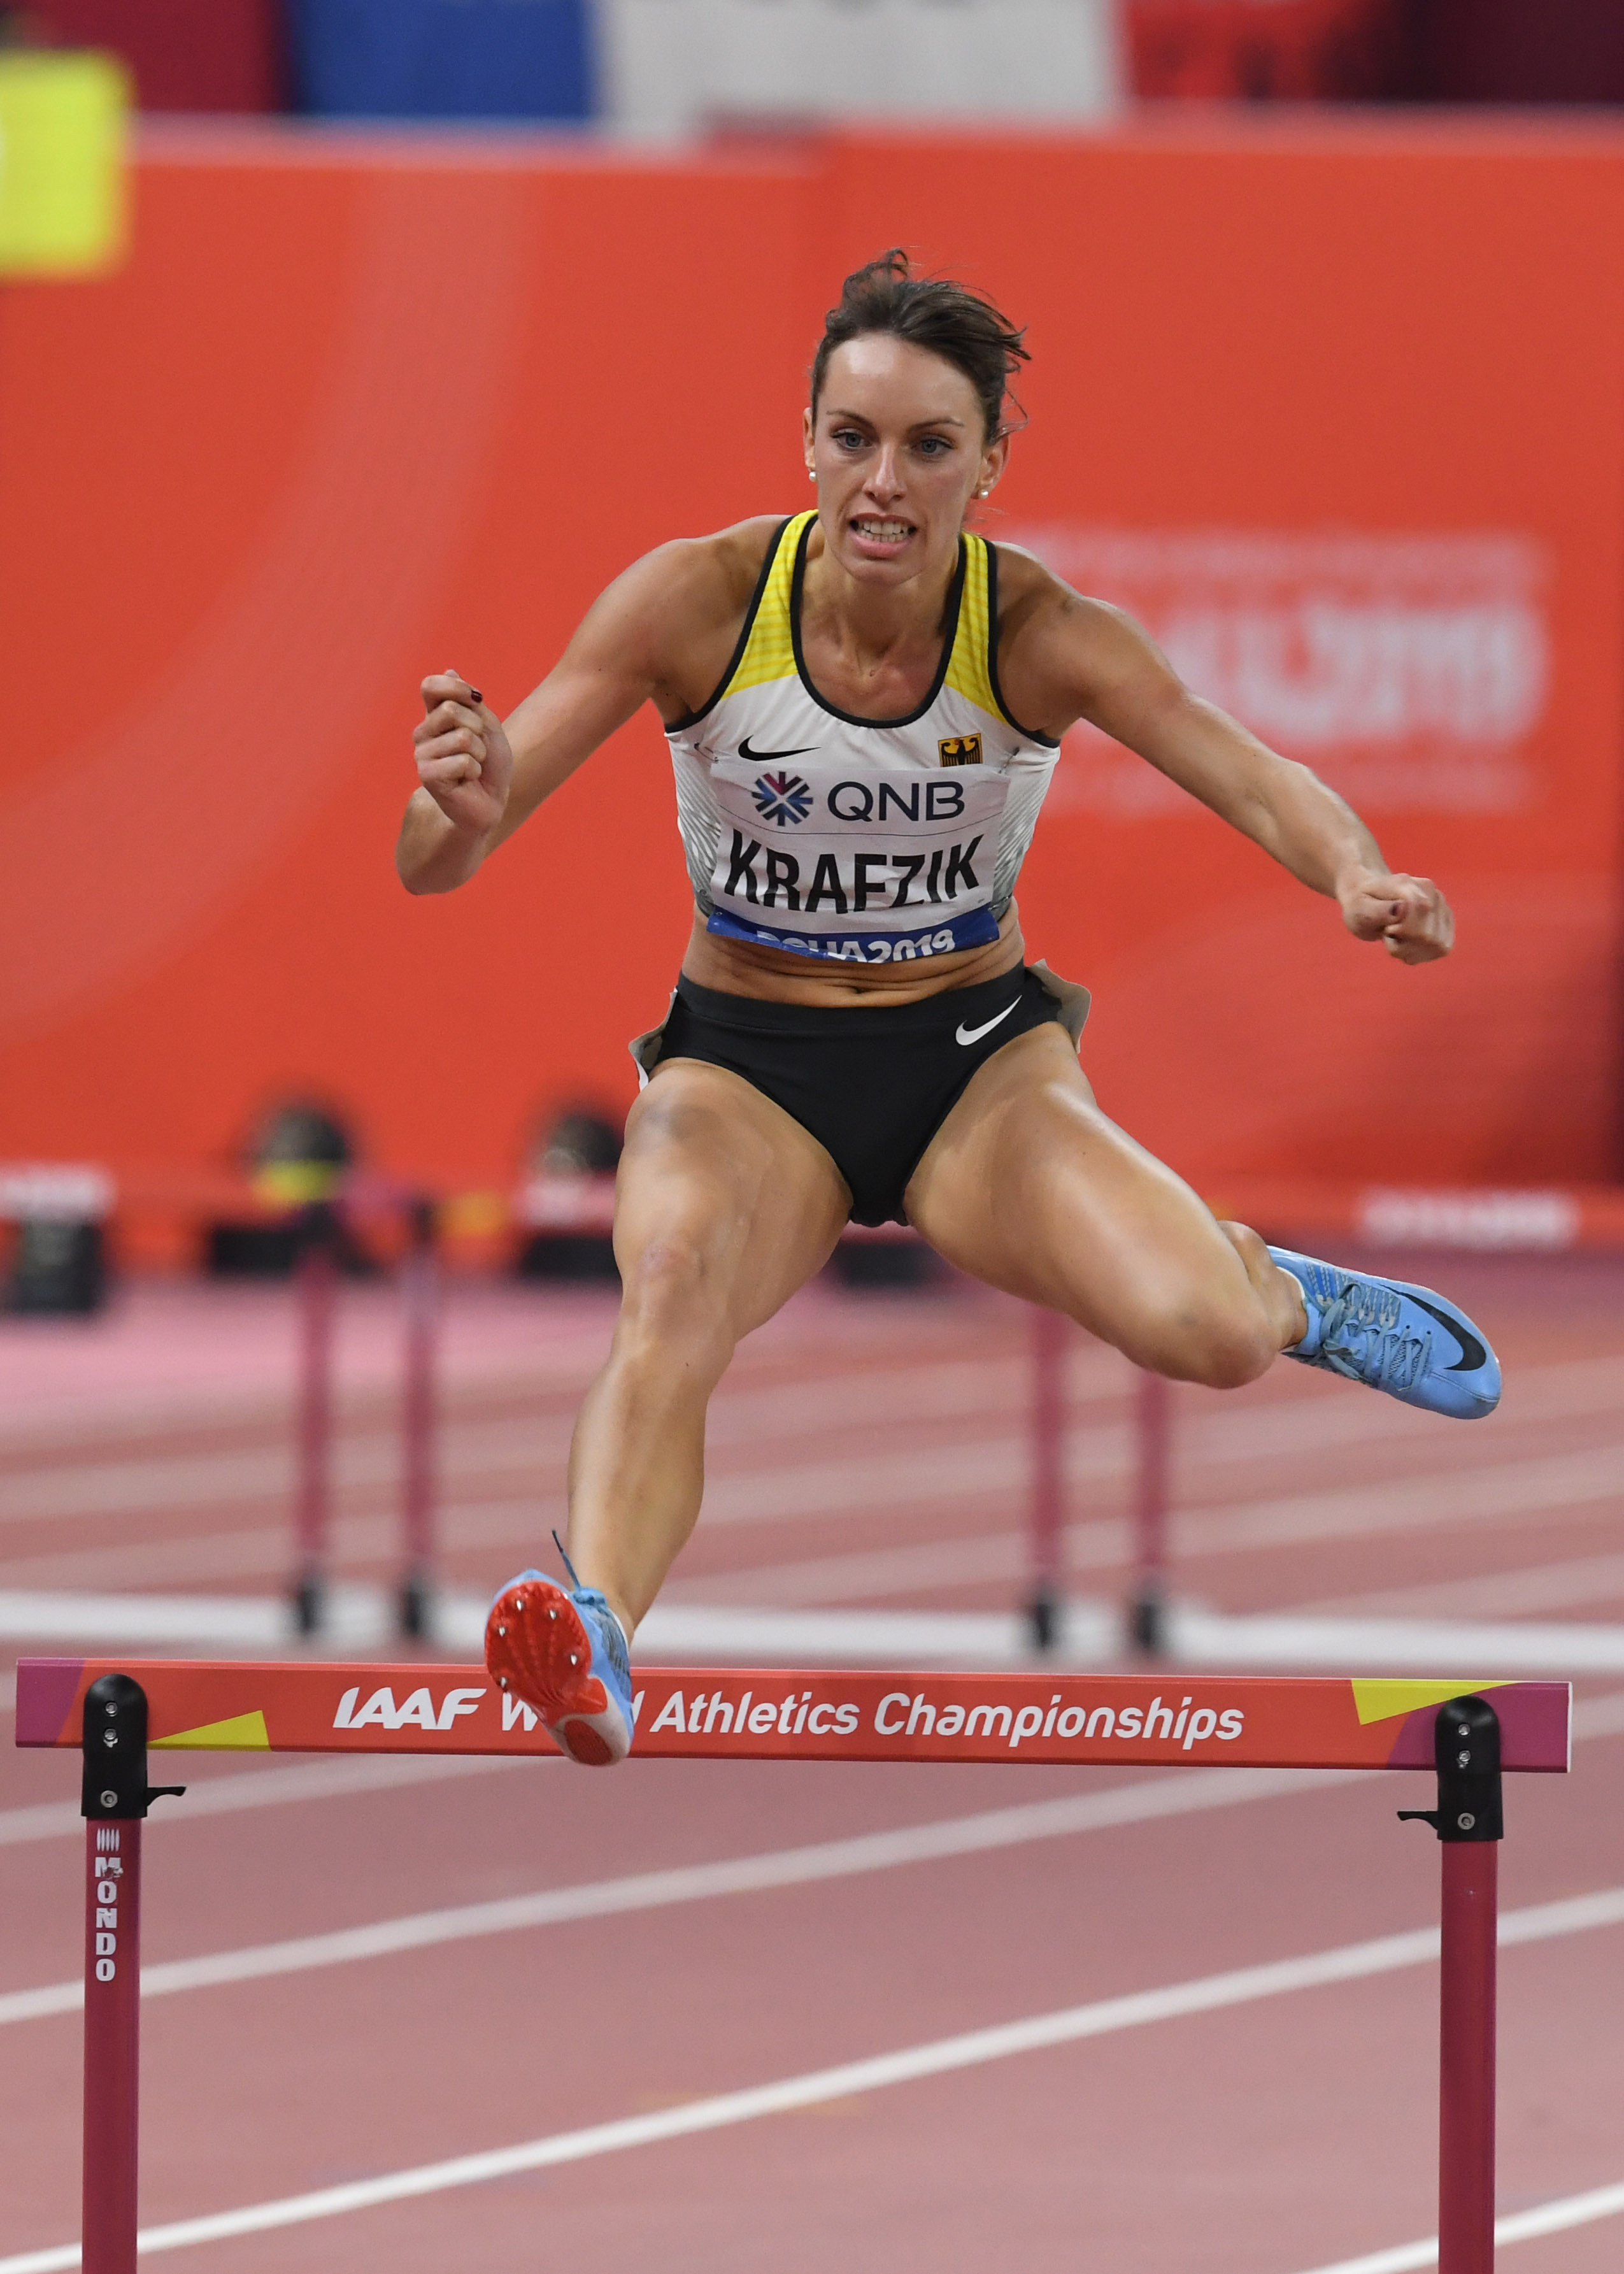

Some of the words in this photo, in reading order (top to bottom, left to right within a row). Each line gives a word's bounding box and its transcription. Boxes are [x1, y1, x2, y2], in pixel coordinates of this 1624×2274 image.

[828, 782, 965, 822] QNB
[724, 829, 984, 914] KRAFZIK
[332, 1687, 487, 1730] IAAF
[649, 1690, 860, 1734] Athletics
[873, 1692, 1244, 1750] Championships
[95, 1856, 124, 1982] MONDO
